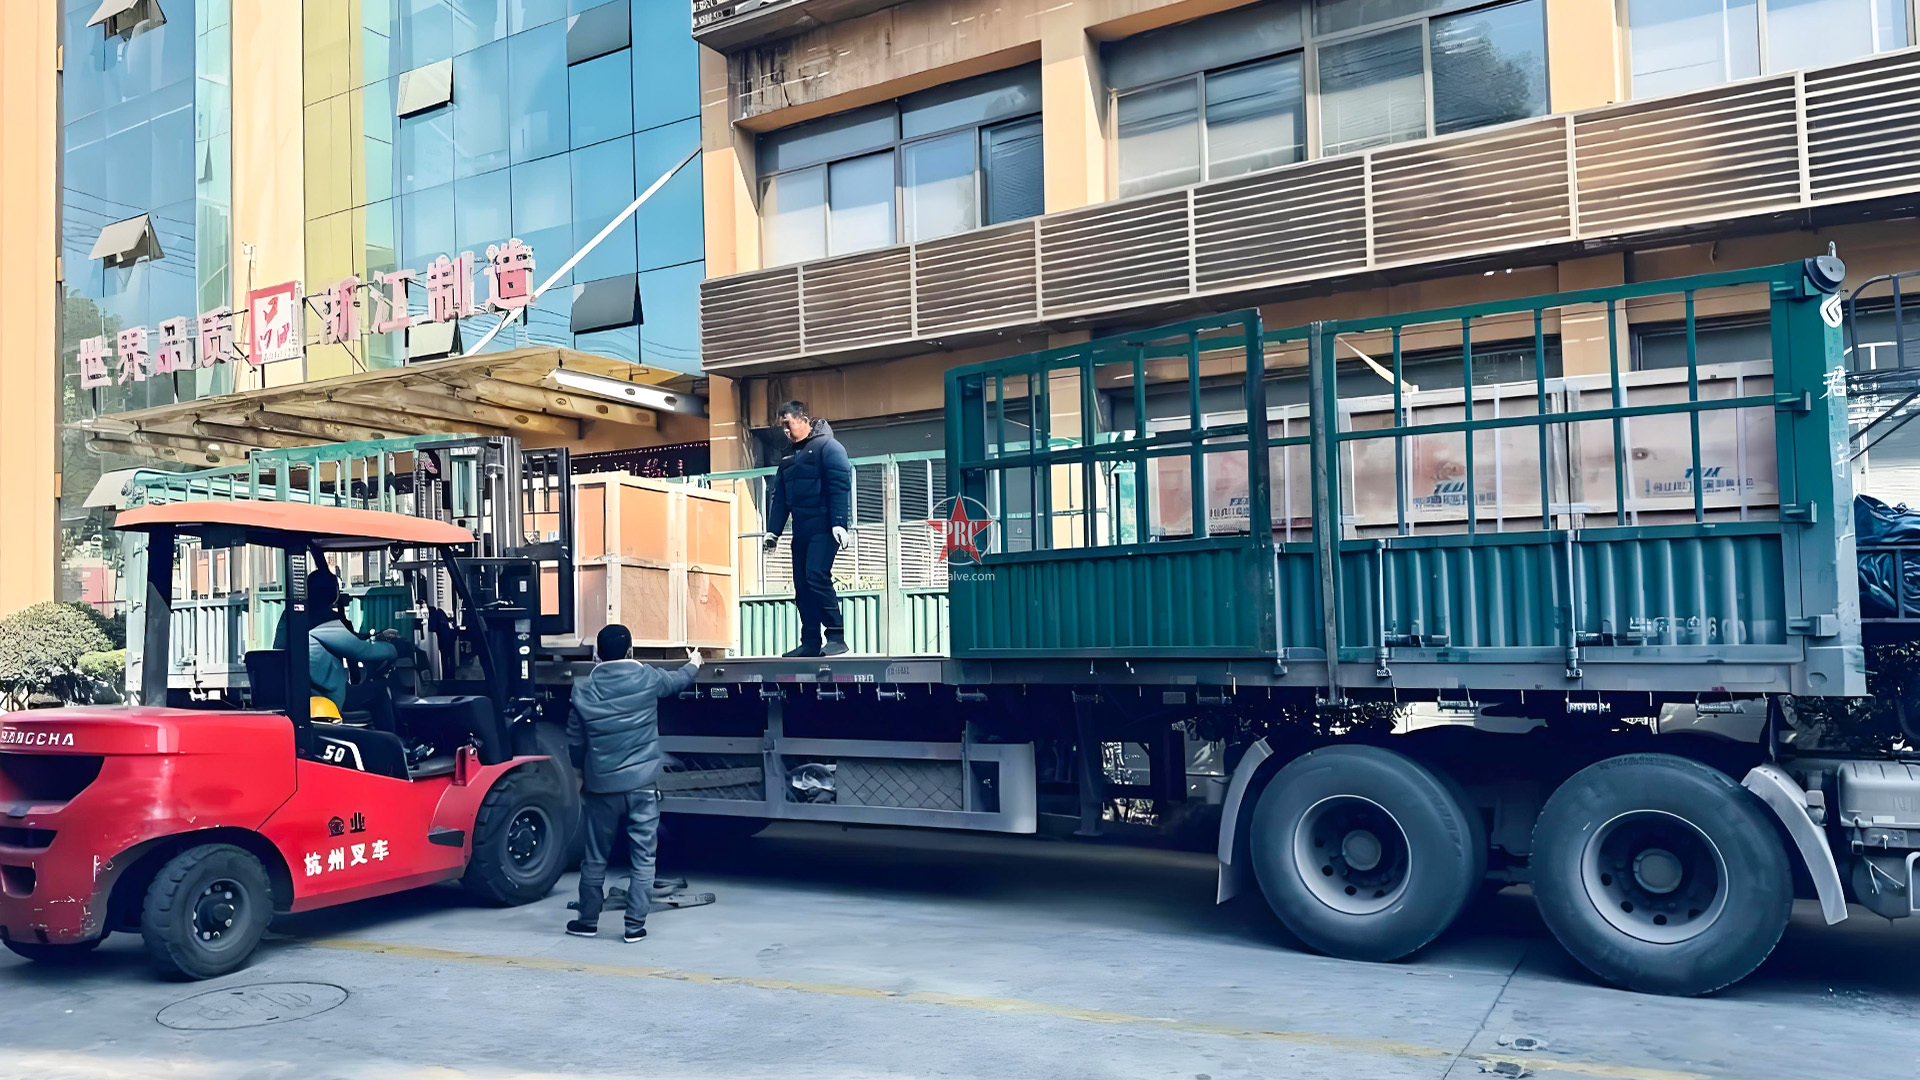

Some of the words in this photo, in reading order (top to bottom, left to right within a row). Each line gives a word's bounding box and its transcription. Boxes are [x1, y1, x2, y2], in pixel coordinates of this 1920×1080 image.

[77, 306, 233, 390] 世界品质
[319, 238, 537, 344] 浙江制造
[322, 744, 347, 763] 50
[303, 839, 390, 877] 杭州叉车
